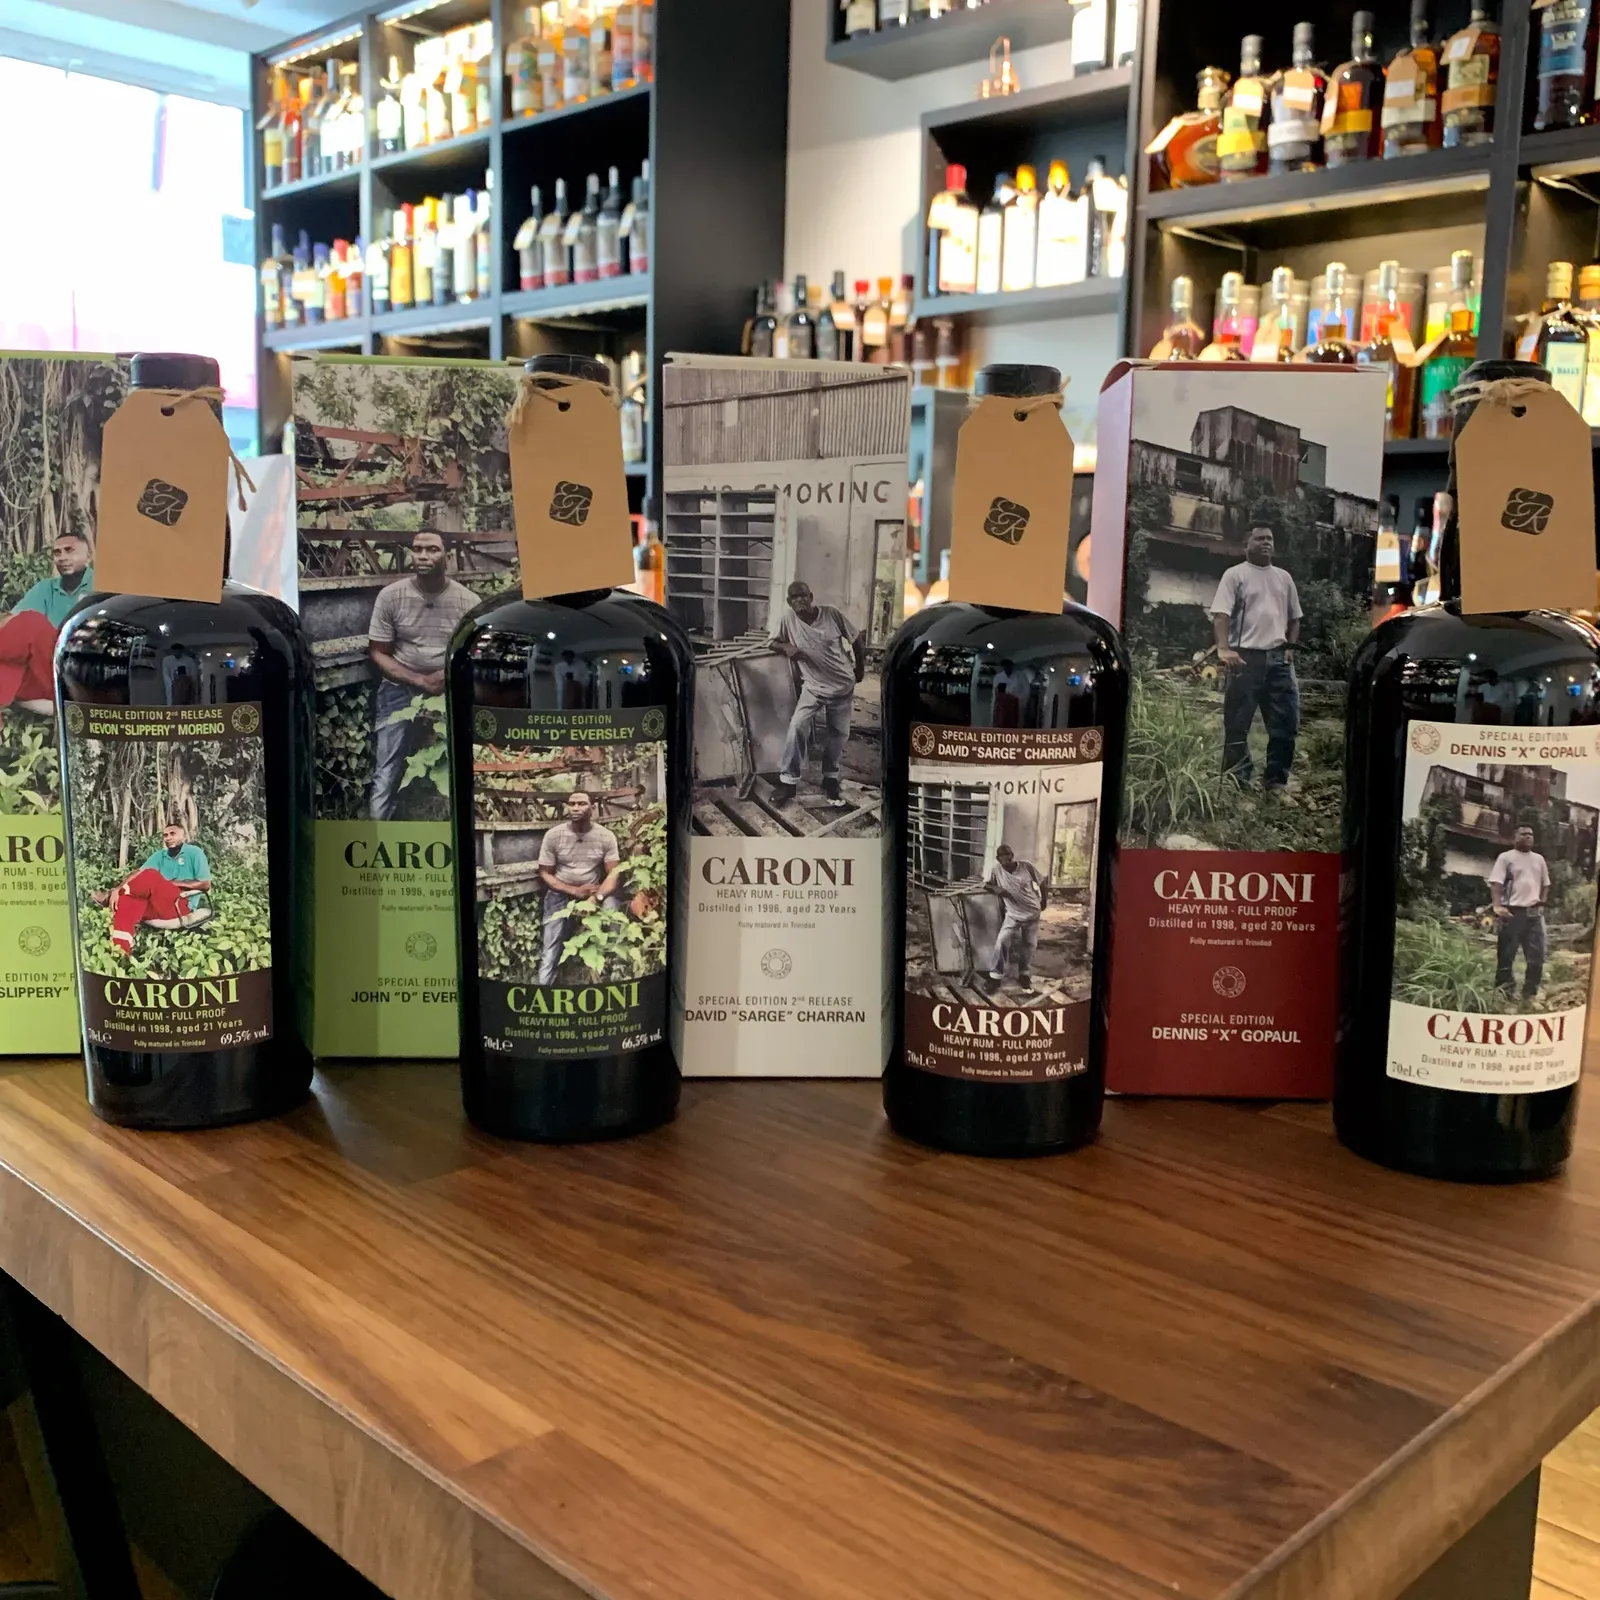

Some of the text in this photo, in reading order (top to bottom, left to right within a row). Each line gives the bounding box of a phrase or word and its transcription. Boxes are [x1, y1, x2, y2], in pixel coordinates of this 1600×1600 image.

[90, 708, 123, 720] SPECIAL
[126, 710, 163, 721] EDITION
[181, 708, 223, 720] RELEASE
[527, 715, 612, 725] SPECIAL EDITION
[89, 722, 225, 736] KEVON "SLIPPERY" MORENO
[504, 727, 636, 741] JOHN "D" EVERSLEY
[1479, 730, 1569, 742] SPECIAL EDITION
[942, 729, 978, 742] SPECIAL
[981, 732, 1019, 744] EDITION
[1036, 733, 1073, 744] RELEASE
[938, 743, 1077, 760] DAVID "SARGE" CHARRAN
[1450, 743, 1588, 759] DENNIS "X" GOPAUL
[4, 867, 27, 877] RUM
[36, 867, 59, 877] FULL
[359, 872, 389, 883] HEAVY
[393, 873, 416, 883] RUM
[425, 873, 448, 883] FULL
[702, 856, 856, 886] CARONI
[12, 881, 67, 893] 1998, aged
[341, 885, 384, 896] Distilled
[388, 886, 397, 896] in
[429, 887, 455, 898] aged
[1153, 869, 1316, 903] CARONI
[716, 889, 840, 900] HEAVY RUM FULL PROOF
[698, 903, 741, 913] Distilled
[744, 904, 753, 913] in
[786, 904, 811, 914] aged
[814, 904, 826, 913] 23
[829, 904, 857, 914] Years
[1168, 903, 1298, 917] HEAVY RUM FULL PROOF
[1148, 917, 1316, 932] Distilled in 1998, aged 20 Years
[1189, 936, 1206, 946] Fully
[5, 973, 49, 983] EDITION
[377, 977, 420, 987] SPECIAL
[104, 977, 239, 1009] CARONI
[350, 991, 391, 1004] JOHN
[394, 991, 418, 1004] "D"
[507, 981, 640, 1015] CARONI
[698, 996, 741, 1006] SPECIAL
[745, 996, 788, 1006] EDITION
[808, 996, 853, 1007] RELEASE
[116, 1008, 227, 1021] HEAVY RUM FULL PROOF
[519, 1012, 629, 1027] HEAVY RUM FULL PROOF
[685, 1009, 866, 1023] DAVID "SARGE" CHARRAN
[932, 1003, 1066, 1037] CARONI
[1180, 1013, 1275, 1026] SPECIAL EDITION
[104, 1019, 243, 1035] Distilled in 1998, aged 21 Years
[504, 1027, 540, 1039] Distilled
[543, 1031, 552, 1040] in
[582, 1029, 605, 1040] aged
[620, 1023, 642, 1034] Years
[1427, 1012, 1567, 1046] CARONI
[220, 1024, 270, 1046] 69,5% vol.
[943, 1033, 1053, 1050] HEAVY RUM FULL PROOF
[1152, 1026, 1302, 1043] DENNIS "X" GOPAUL
[134, 1039, 147, 1048] Fully
[174, 1039, 180, 1047] in
[181, 1039, 206, 1047] Trinidad
[929, 1042, 964, 1059] Distilled
[967, 1050, 976, 1060] in
[1006, 1052, 1029, 1064] aged
[1031, 1052, 1042, 1062] 23
[1044, 1050, 1067, 1061] Years
[1440, 1044, 1472, 1056] HEAVY
[1474, 1048, 1497, 1058] RUM
[1506, 1049, 1527, 1059] FULL
[1421, 1054, 1464, 1069] Distilled
[1467, 1060, 1477, 1070] in
[1509, 1061, 1531, 1073] aged
